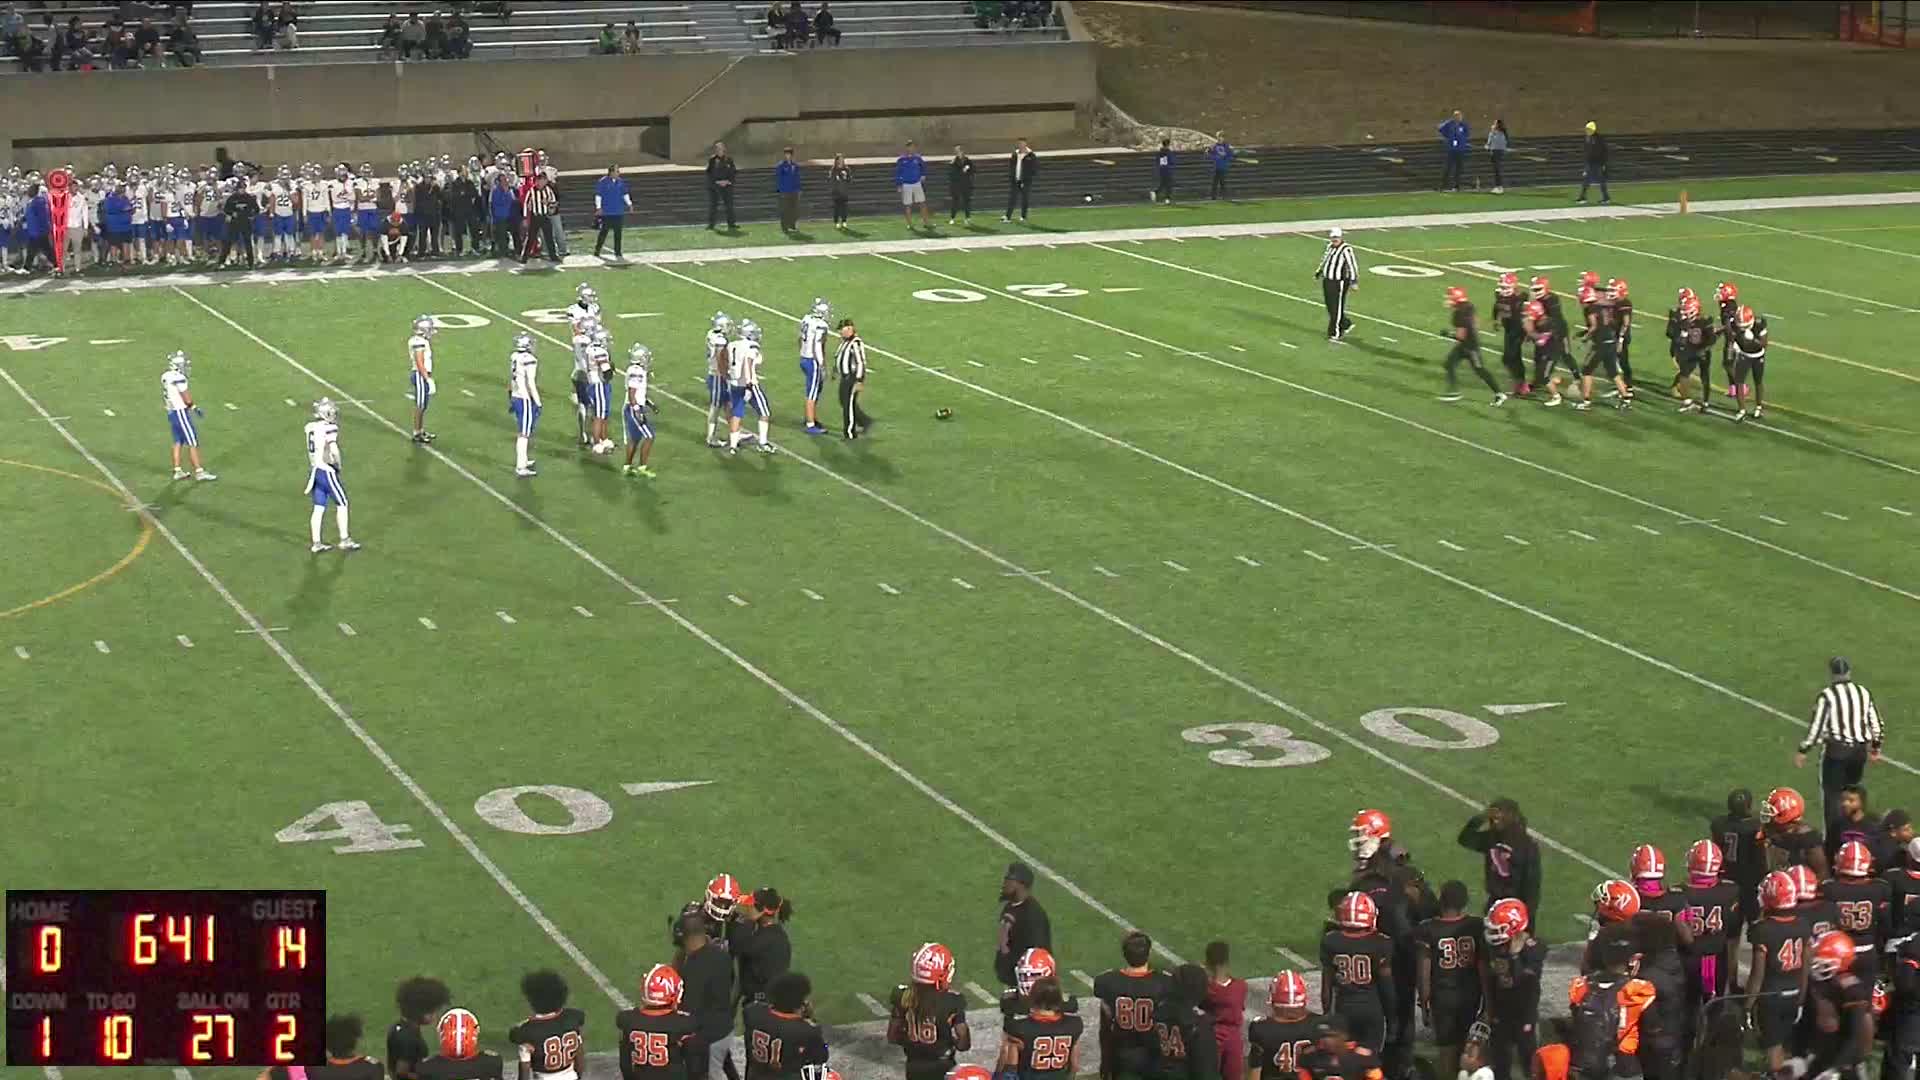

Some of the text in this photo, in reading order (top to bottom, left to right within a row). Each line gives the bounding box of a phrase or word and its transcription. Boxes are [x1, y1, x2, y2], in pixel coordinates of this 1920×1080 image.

[1181, 707, 1500, 768] 30
[275, 784, 614, 855] 40
[1837, 901, 1873, 930] 53
[1333, 954, 1372, 985] 30
[1777, 938, 1802, 971] 41
[1115, 996, 1154, 1032] 60
[543, 1031, 579, 1071] 82
[629, 1031, 669, 1067] 35
[752, 1029, 783, 1069] 51
[1031, 1036, 1072, 1070] 25
